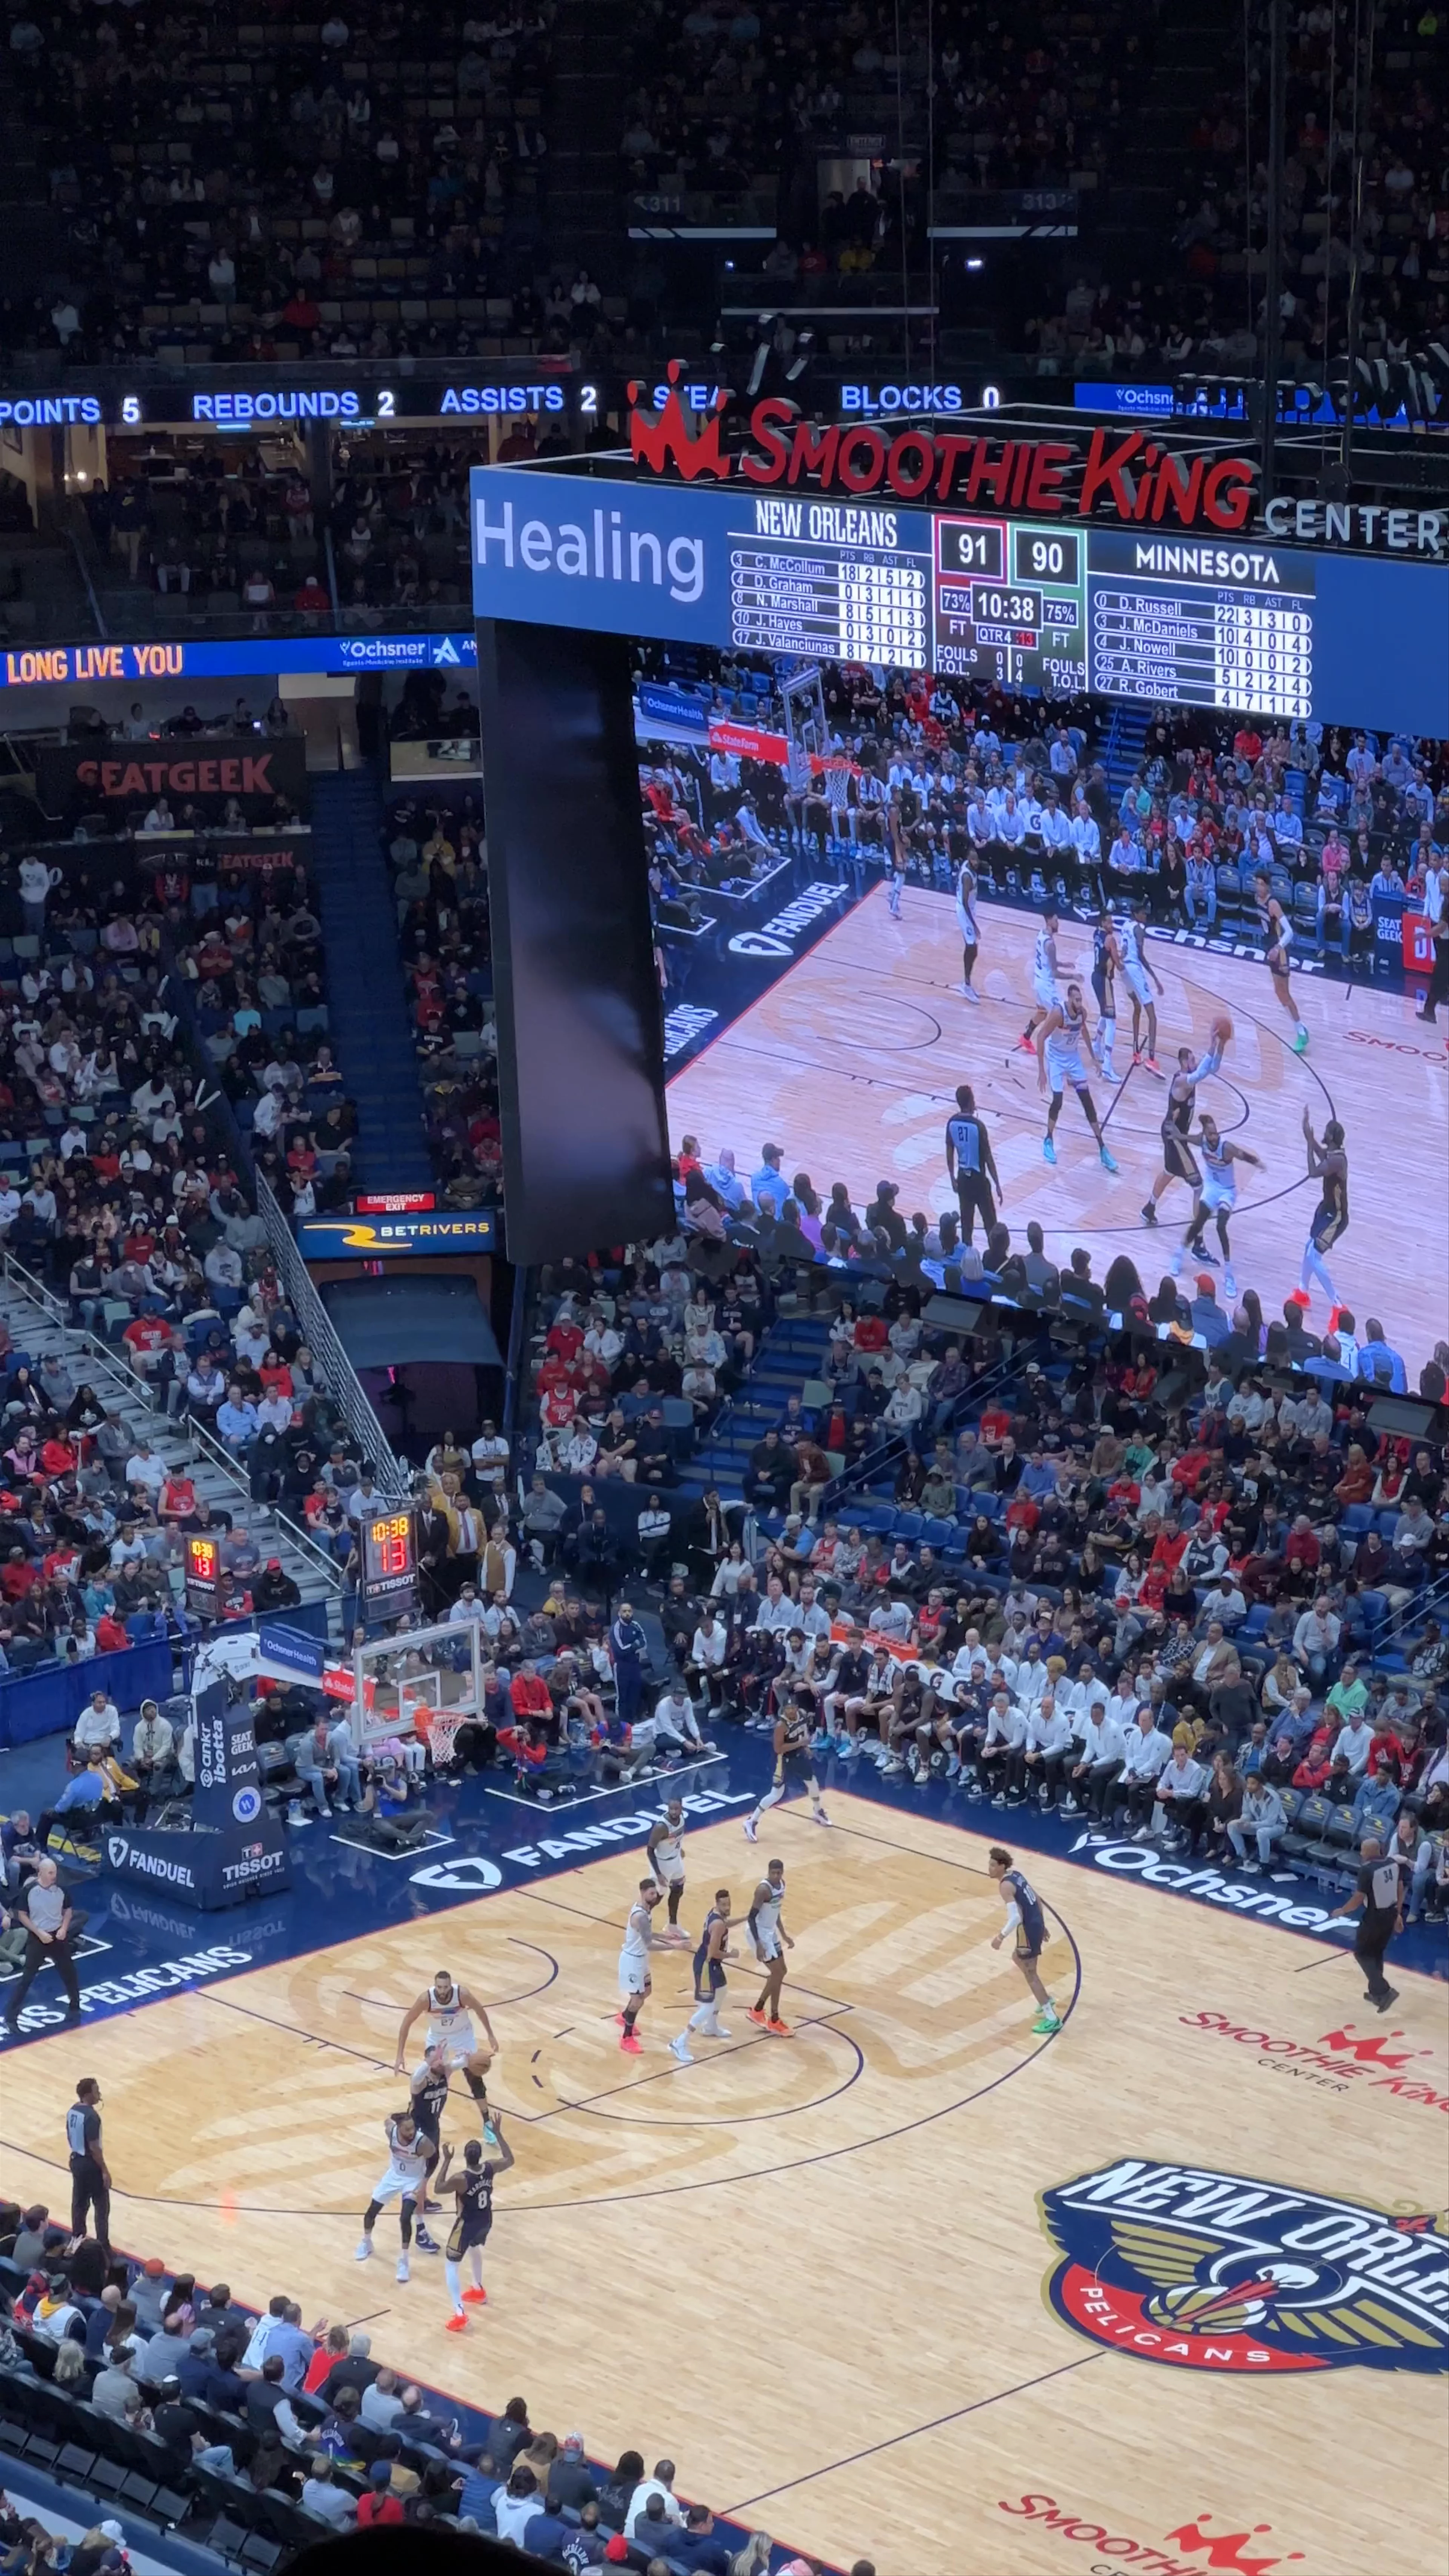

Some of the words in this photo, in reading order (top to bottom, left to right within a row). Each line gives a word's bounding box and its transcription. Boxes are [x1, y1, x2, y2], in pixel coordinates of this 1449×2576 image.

[122, 396, 140, 423] 5
[193, 391, 360, 419] REBOUNDS
[377, 391, 395, 417] 2
[440, 385, 563, 414] ASSISTS
[581, 386, 596, 411] 2
[842, 385, 962, 411] BLOCKS
[983, 386, 1000, 409] 0
[743, 398, 1071, 510] SMOOTHIE
[755, 500, 802, 537] NEW
[809, 505, 897, 547] ORLEANS
[1265, 497, 1440, 551] CENTER
[476, 499, 704, 602] Healing
[840, 550, 856, 561] PTS
[863, 552, 875, 563] RB
[882, 556, 898, 566] AST
[906, 558, 917, 567] FL
[958, 533, 986, 565] 91
[1032, 541, 1063, 573] 90
[1136, 542, 1280, 583] MINNESOTA
[735, 554, 743, 567] 3
[755, 555, 767, 569] C.
[770, 557, 826, 575] McCollum
[842, 564, 856, 580] 18
[865, 567, 873, 583] 2
[886, 569, 894, 585] 5
[906, 572, 915, 587] 2
[737, 573, 743, 585] 4
[755, 575, 766, 588] D.
[769, 577, 813, 594] Graham
[845, 584, 852, 600] 0
[866, 587, 873, 602] 3
[887, 589, 893, 604] 1
[908, 591, 914, 607] 1
[1217, 591, 1235, 603] PTS
[1243, 594, 1256, 605] RB
[1264, 597, 1283, 608] AST
[1292, 599, 1303, 611] FL
[737, 591, 743, 604] 8
[757, 593, 768, 607] N.
[771, 594, 818, 612] Marshall
[846, 604, 854, 619] 8
[866, 606, 874, 622] 5
[887, 609, 893, 624] 1
[907, 611, 915, 626] 3
[944, 592, 971, 612] 73%
[978, 592, 1035, 622] 10:38
[1046, 604, 1075, 623] 75%
[1099, 594, 1107, 607] 0
[1120, 595, 1132, 611] D.
[1136, 597, 1182, 616] Russell
[1217, 606, 1235, 624] 22
[1244, 609, 1252, 626] 3
[1267, 612, 1276, 629] 3
[1292, 615, 1301, 632] 0
[737, 611, 749, 624] 10
[756, 613, 766, 626] J.
[769, 614, 803, 632] Hayes
[846, 623, 854, 638] 0
[866, 626, 874, 641] 3
[887, 628, 894, 644] 0
[908, 630, 915, 646] 2
[949, 619, 967, 636] FT
[1052, 632, 1069, 648] FT
[1099, 614, 1107, 628] 3
[1119, 617, 1130, 631] J.
[1134, 618, 1198, 638] McDaniels
[1218, 627, 1235, 644] 10
[1244, 630, 1252, 647] 4
[1268, 633, 1277, 649] 0
[1292, 635, 1301, 652] 4
[7, 649, 68, 684] LONG
[76, 646, 123, 678] LIVE
[132, 644, 183, 676] YOU
[351, 640, 426, 658] Ochsner
[737, 631, 750, 644] 17
[756, 632, 766, 645] J.
[768, 633, 835, 654] Valanciunas
[847, 643, 854, 659] 8
[867, 646, 874, 662] 7
[888, 649, 895, 665] 2
[909, 651, 915, 667] 1
[937, 644, 978, 662] FOULS
[997, 651, 1003, 665] 0
[1016, 653, 1023, 667] 0
[1043, 657, 1085, 676] FOULS
[1099, 634, 1107, 648] 4
[1120, 637, 1131, 651] J.
[1134, 638, 1176, 657] Nowell
[1218, 647, 1235, 665] 10
[1245, 651, 1253, 667] 0
[1268, 654, 1277, 670] 0
[1292, 657, 1301, 674] 2
[937, 659, 970, 676] T.O.L.
[997, 666, 1003, 681] 3
[1015, 669, 1023, 683] 4
[1051, 673, 1085, 690] T.O.L.
[1100, 656, 1114, 671] 25
[1121, 658, 1134, 673] A.
[1137, 660, 1177, 678] Rivers
[1222, 668, 1231, 685] 5
[1245, 672, 1253, 688] 2
[1268, 675, 1277, 691] 2
[1292, 678, 1301, 695] 4
[1100, 676, 1114, 690] 27
[1119, 678, 1132, 693] R.
[1135, 680, 1178, 699] Gobert
[1222, 690, 1231, 707] 4
[1245, 693, 1253, 709] 7
[1269, 696, 1275, 713] 1
[1292, 699, 1301, 716] 4
[761, 881, 850, 938] FANDUEL
[958, 1126, 968, 1142] 27
[367, 1194, 424, 1204] EMERGENCY
[385, 1203, 406, 1211] EXIT
[381, 1223, 489, 1237] BETRIVERS
[372, 1516, 408, 1542] 10:38
[198, 1556, 210, 1576] 13
[383, 1538, 405, 1572] 13
[381, 1573, 416, 1591] TISSOT
[200, 1722, 212, 1767] ankr
[212, 1719, 226, 1784] ibotta
[231, 1730, 252, 1746] SEAT
[231, 1741, 254, 1756] GEEK
[129, 1851, 195, 1888] FANDUEL
[222, 1850, 284, 1882] TISSOT
[1094, 1847, 1360, 1933] Ochsner
[1179, 2012, 1376, 2078] SMOOTHIE
[1257, 2058, 1350, 2092] CENTER
[431, 2098, 441, 2114] 17
[478, 2190, 488, 2209] 8
[1057, 2161, 1306, 2227] NEW
[1080, 2287, 1271, 2364] PELICANS
